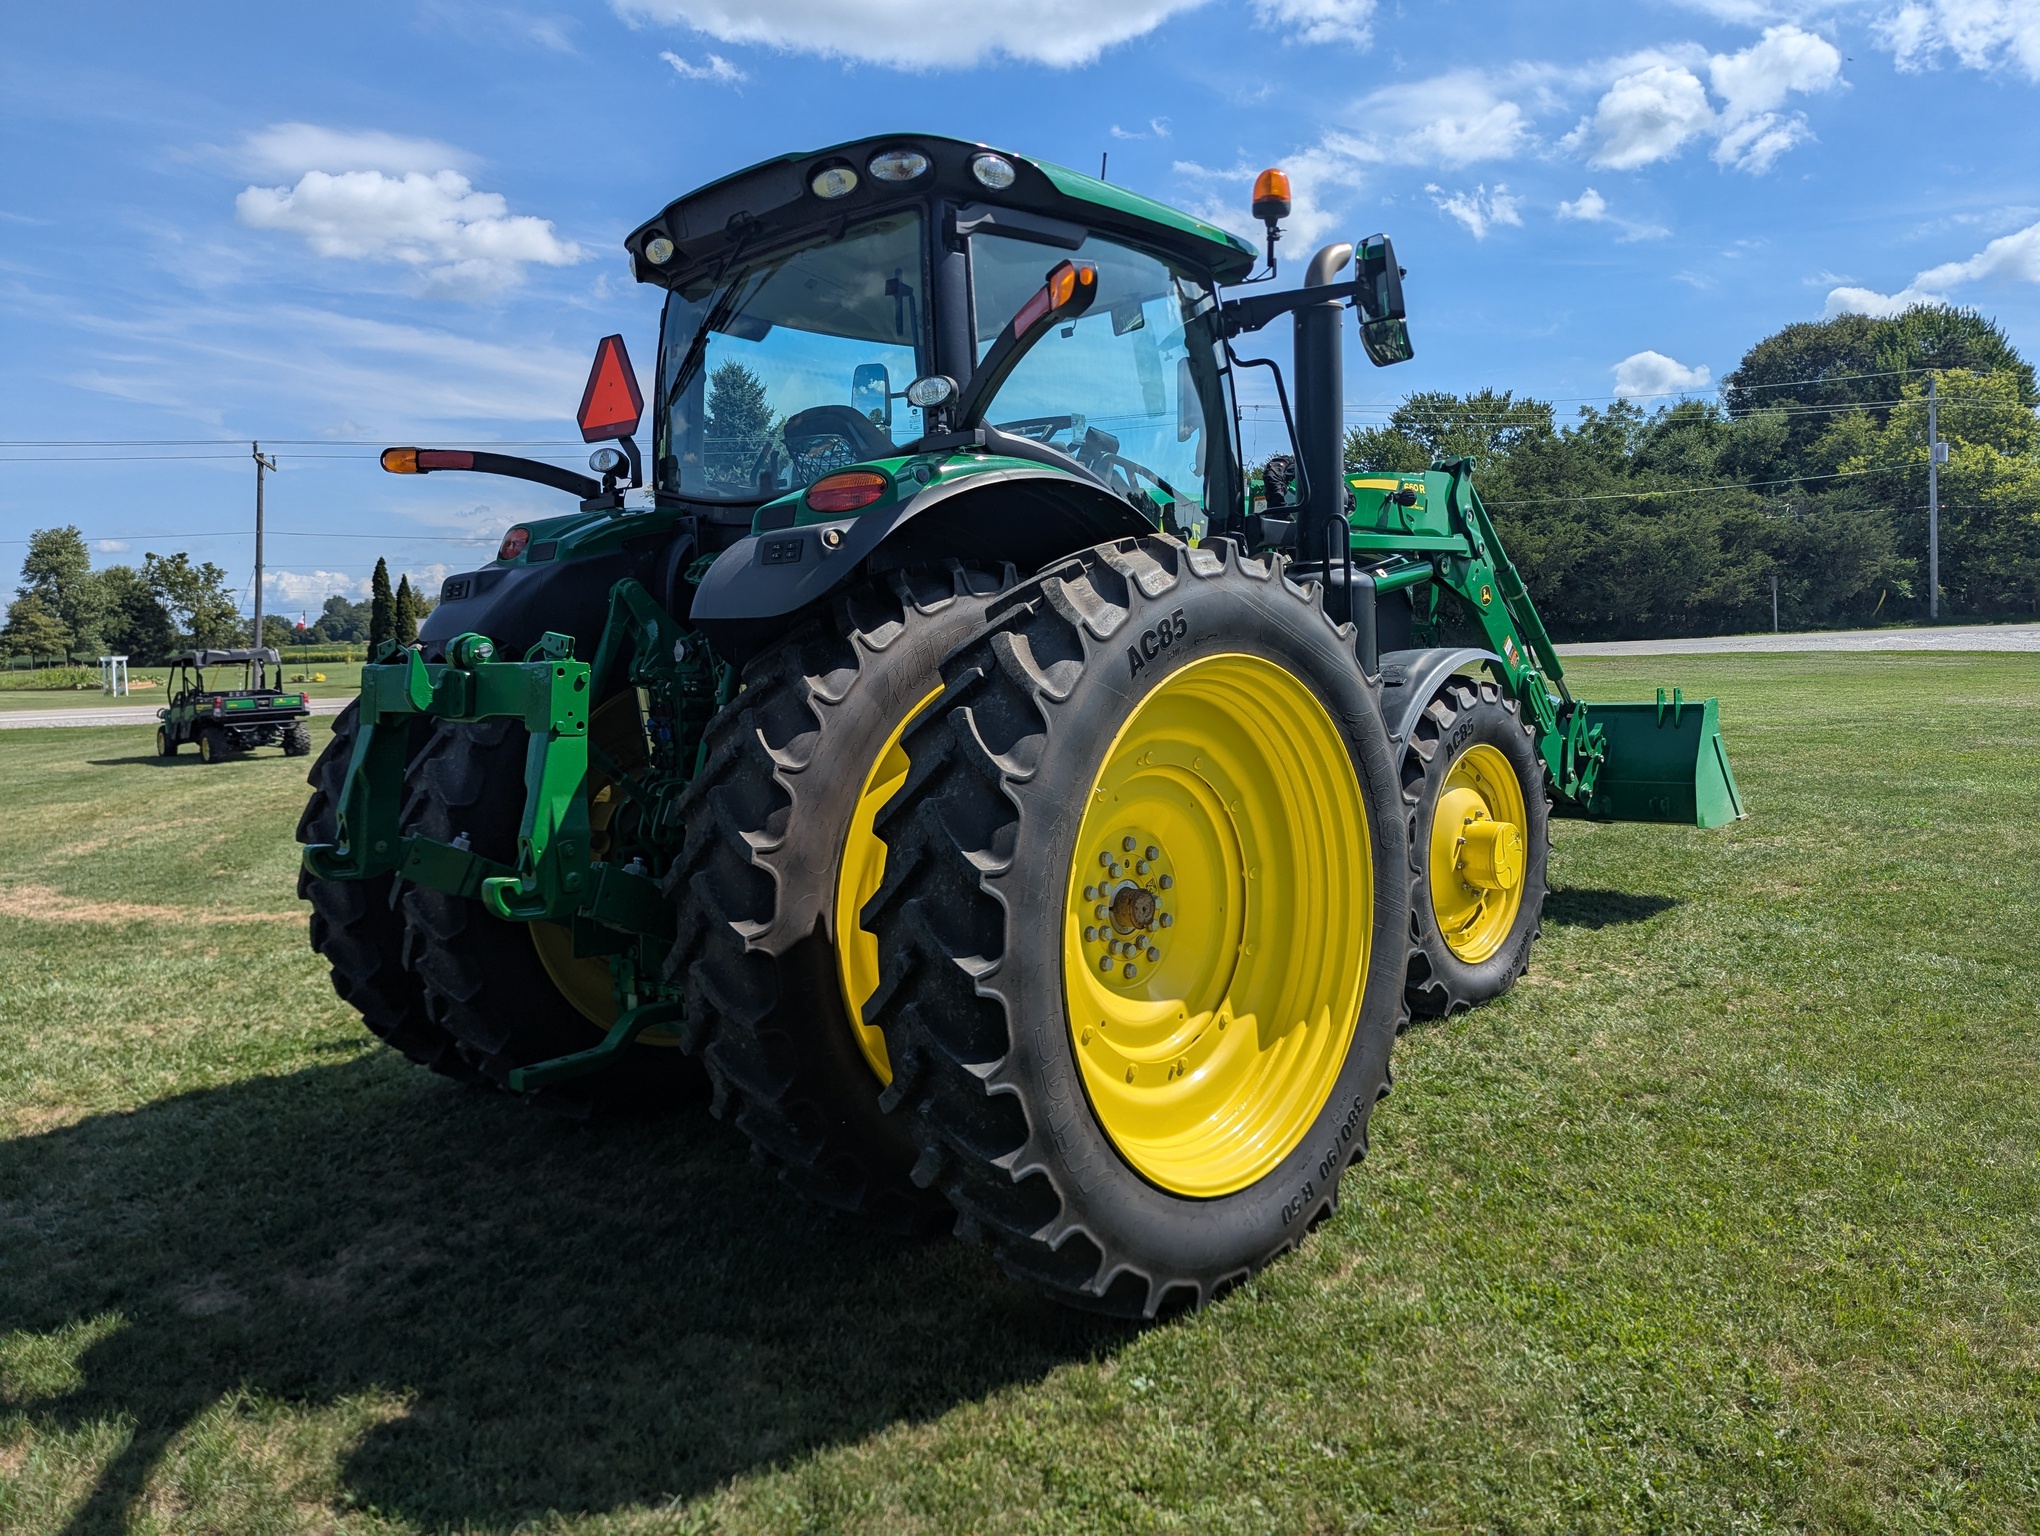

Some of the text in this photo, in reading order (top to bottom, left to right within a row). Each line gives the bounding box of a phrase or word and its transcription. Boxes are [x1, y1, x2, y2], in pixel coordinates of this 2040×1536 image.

[1127, 606, 1188, 682] AC85
[1446, 715, 1474, 763] AC85
[1319, 1094, 1364, 1181] 380/90
